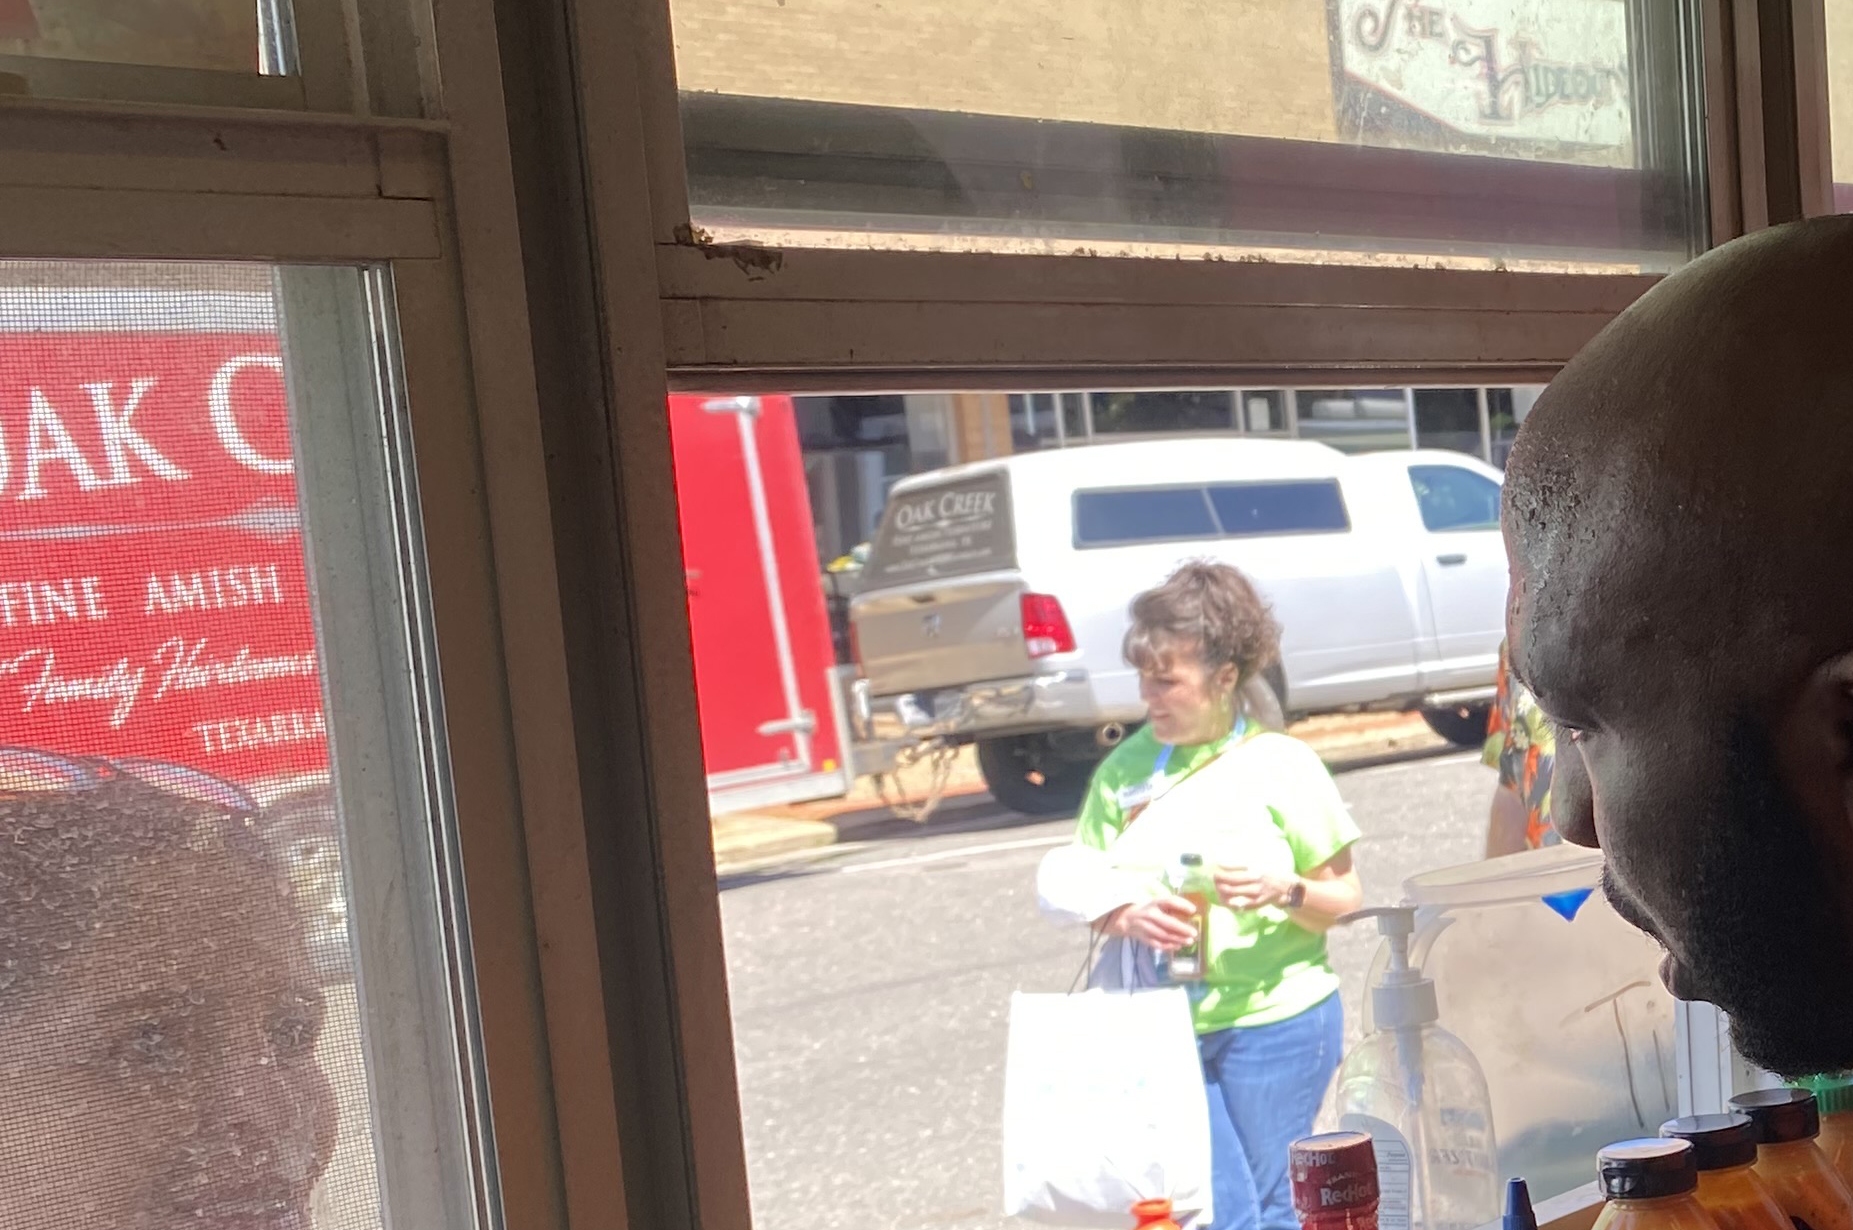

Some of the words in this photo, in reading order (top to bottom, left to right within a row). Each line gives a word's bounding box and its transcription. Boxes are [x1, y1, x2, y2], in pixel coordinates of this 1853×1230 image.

[0, 376, 192, 502] AK
[939, 490, 996, 518] CREEK
[0, 576, 108, 628] FINE
[145, 564, 284, 616] AMISH
